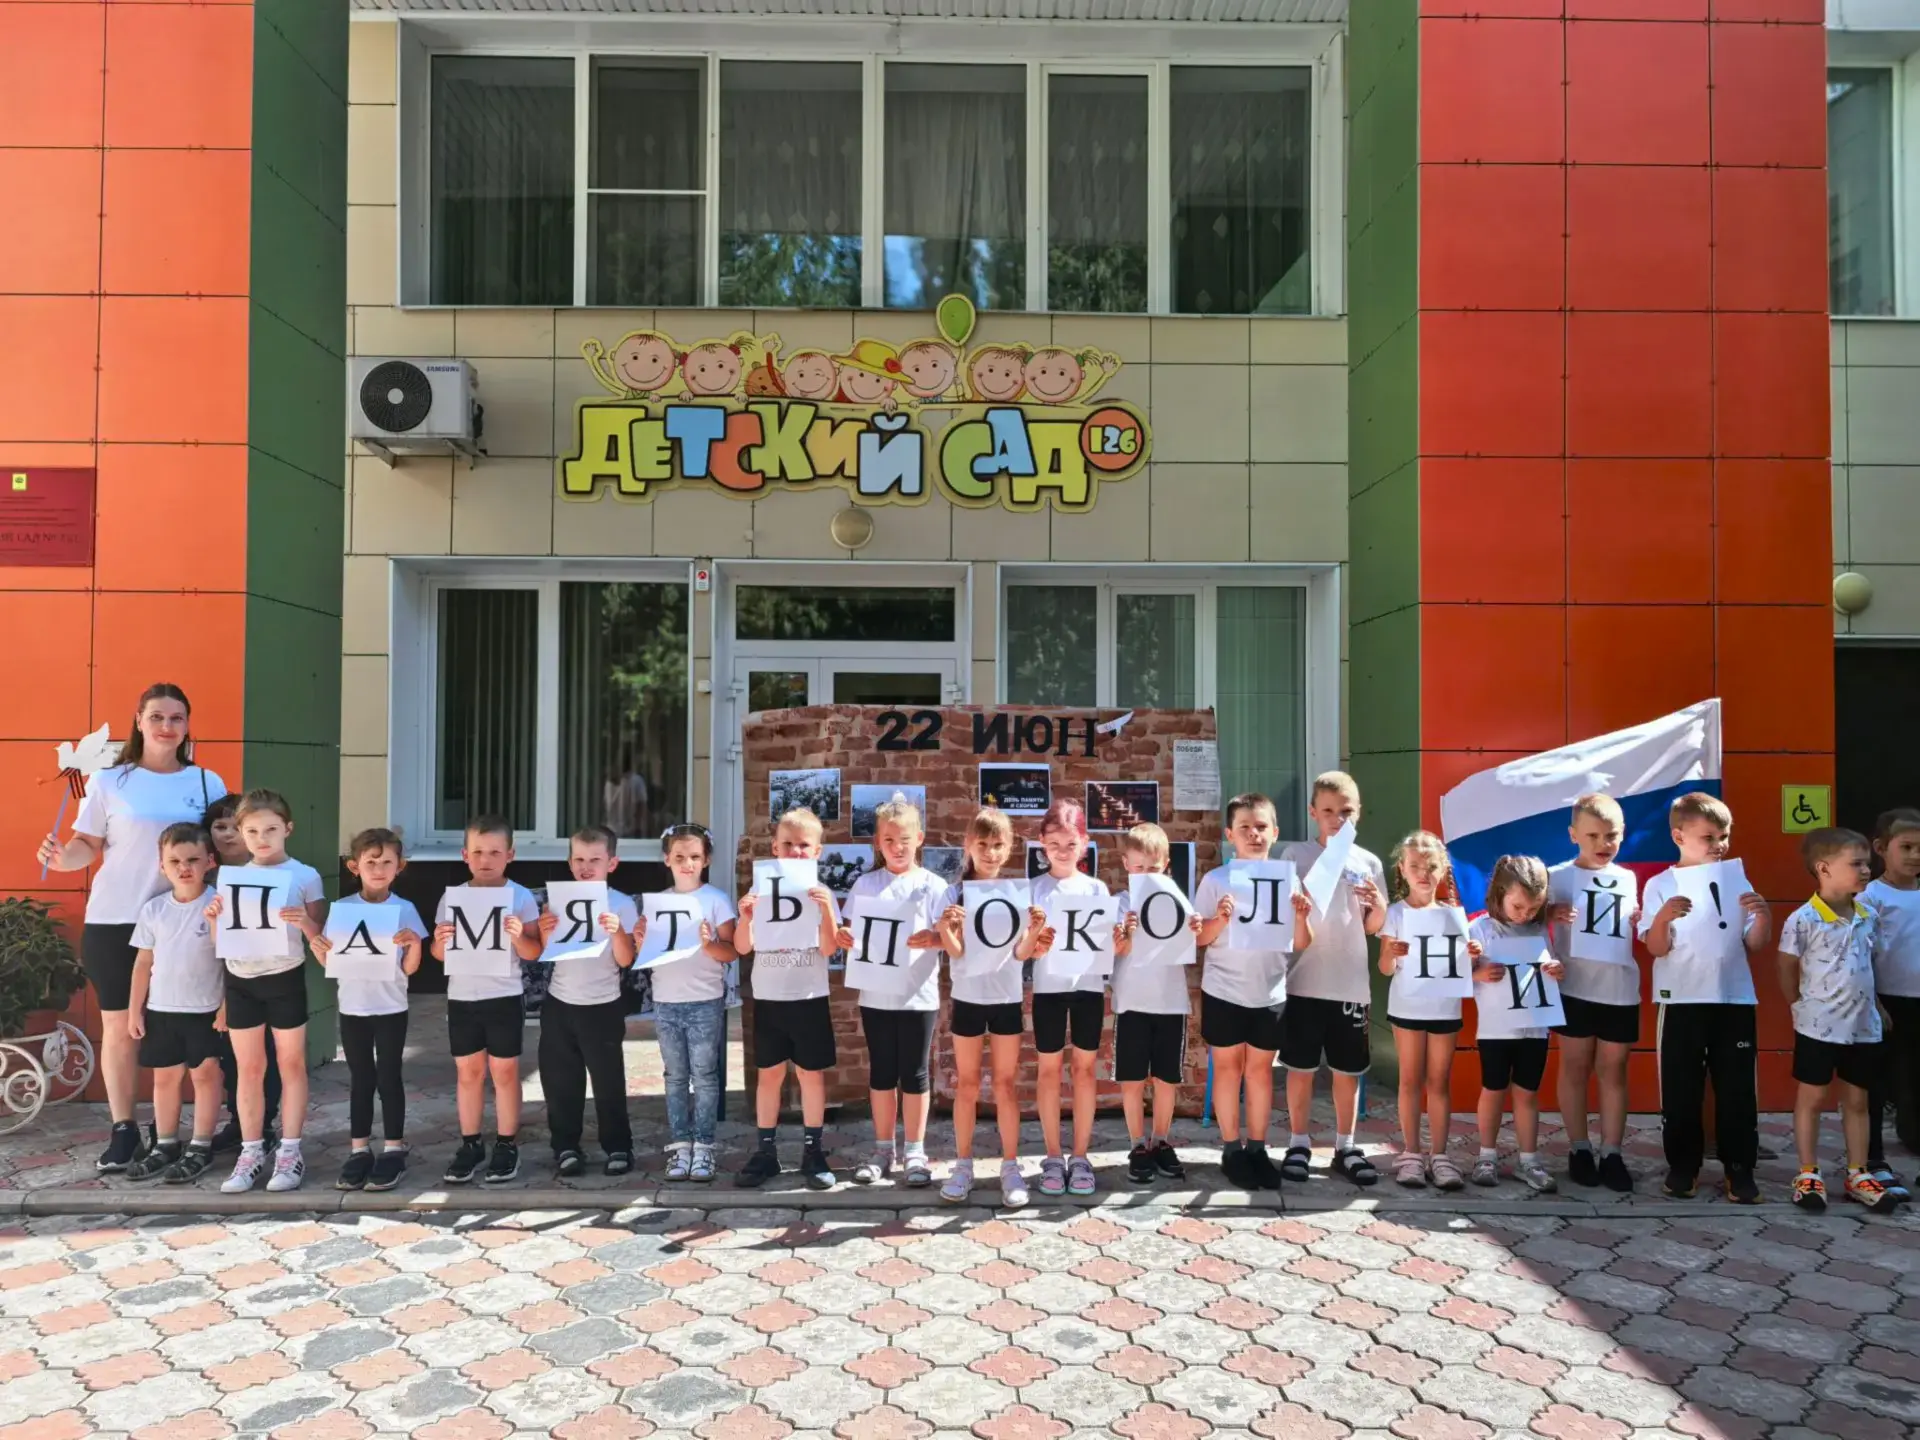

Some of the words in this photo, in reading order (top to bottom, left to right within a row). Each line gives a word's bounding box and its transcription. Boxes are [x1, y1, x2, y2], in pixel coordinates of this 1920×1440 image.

[563, 401, 925, 497] ДЕТСКИЙ
[940, 406, 1097, 504] САД
[1088, 424, 1137, 455] 126
[876, 710, 943, 751] 22
